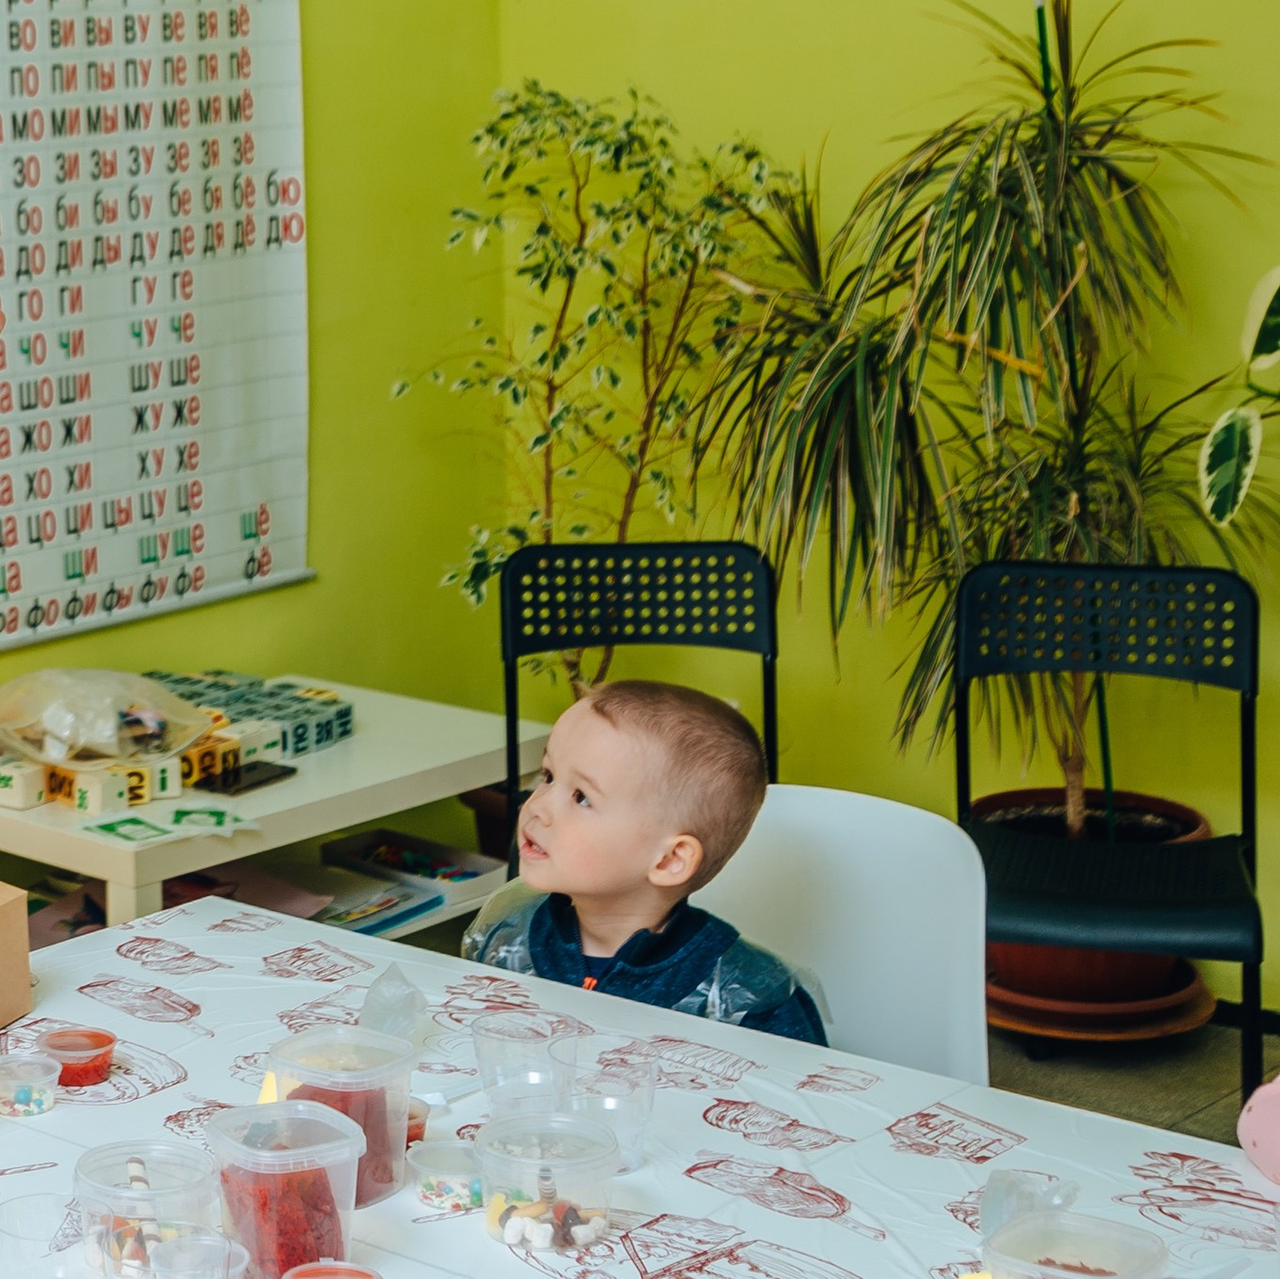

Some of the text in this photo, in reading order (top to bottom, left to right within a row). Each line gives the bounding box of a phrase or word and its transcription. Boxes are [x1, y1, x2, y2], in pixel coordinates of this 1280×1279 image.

[9, 19, 37, 52] во
[51, 19, 75, 48] ви
[86, 17, 113, 47] вы
[125, 14, 150, 44] ву
[162, 11, 185, 42] ве
[11, 65, 39, 97] по
[52, 63, 77, 94] пи
[88, 61, 115, 91] пы
[125, 58, 151, 88] пу
[163, 55, 187, 86] пе
[11, 108, 44, 141] мо
[52, 108, 81, 137] ми
[87, 104, 118, 135] мы
[125, 102, 153, 131] му
[163, 97, 190, 129] ме
[13, 155, 41, 188] зо
[56, 152, 80, 184] зи
[91, 149, 118, 180] зы
[128, 145, 154, 176] зу
[167, 141, 190, 173] зе
[17, 198, 43, 235] бо
[56, 194, 79, 231] би
[93, 189, 118, 225] бы
[128, 184, 152, 221] бу
[169, 180, 192, 217] бе
[267, 168, 301, 206] бю
[16, 243, 46, 282] до
[56, 239, 83, 277] ди
[93, 235, 121, 272] ды
[130, 231, 159, 268] ду
[170, 225, 195, 263] де
[267, 212, 304, 251] дю
[19, 289, 44, 321] го
[60, 285, 83, 316] ги
[132, 275, 157, 305] гу
[172, 270, 193, 301] ге
[20, 333, 47, 366] чо
[59, 329, 84, 359] чи
[131, 318, 157, 348] чу
[171, 312, 195, 343] че
[20, 376, 54, 411] шо
[59, 372, 91, 405] ши
[130, 360, 162, 393] шу
[170, 354, 201, 387] ше
[61, 414, 92, 448] жи
[133, 402, 164, 434] жу
[173, 395, 201, 427] же
[25, 467, 52, 501] хо
[66, 461, 92, 494] хи
[138, 447, 164, 480] ху
[177, 441, 200, 472] хе
[27, 509, 57, 549] цо
[66, 502, 93, 540] ци
[104, 496, 132, 534] цы
[140, 489, 166, 525] цу
[177, 479, 203, 516] це
[65, 547, 98, 585] щи
[140, 532, 169, 569] щу
[174, 523, 205, 560] ще
[27, 598, 60, 635] фо
[65, 591, 97, 624] фи
[103, 582, 133, 616] фы
[140, 574, 169, 607] фу
[176, 565, 205, 599] фе
